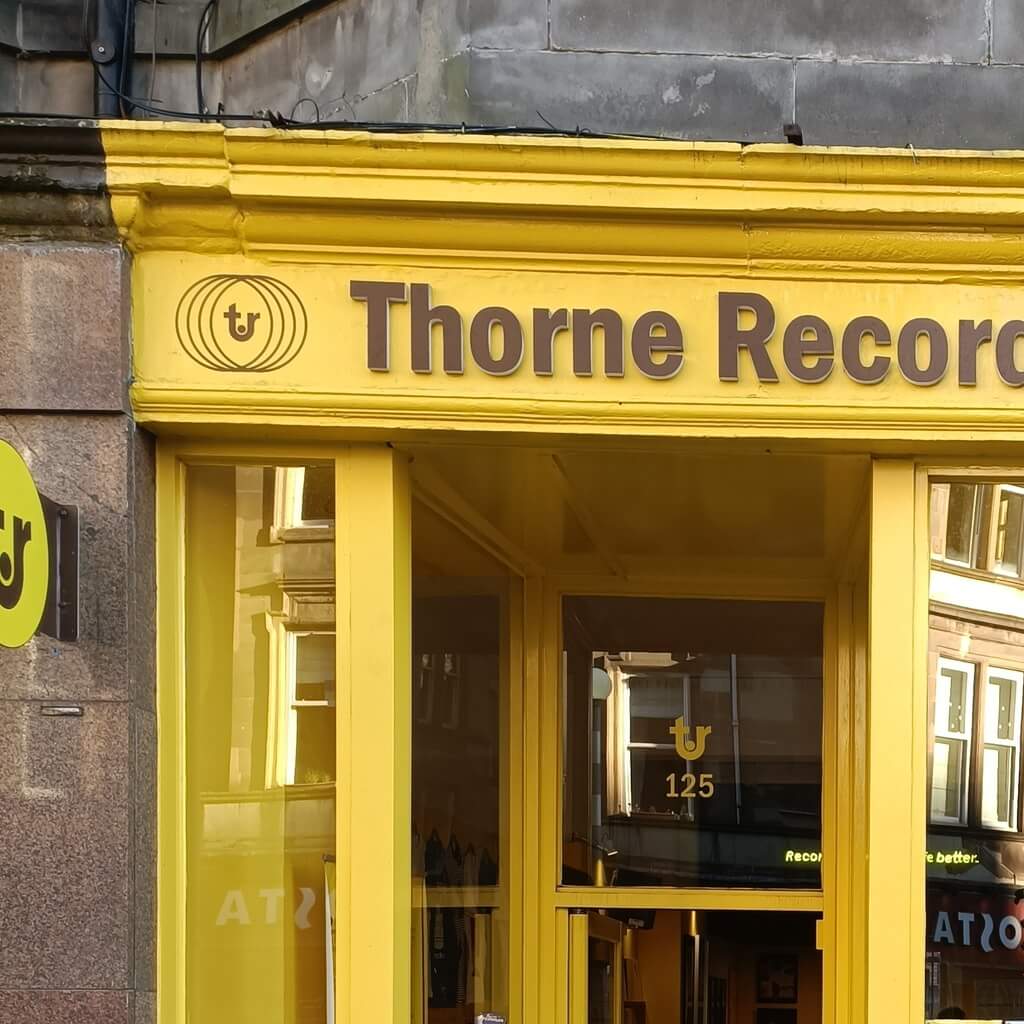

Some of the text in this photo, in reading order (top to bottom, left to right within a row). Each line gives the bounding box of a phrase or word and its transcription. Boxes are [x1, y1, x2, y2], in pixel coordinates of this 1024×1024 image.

[350, 281, 686, 379] Thorne
[665, 774, 714, 798] 125
[785, 850, 822, 862] Recor
[936, 850, 979, 863] better.
